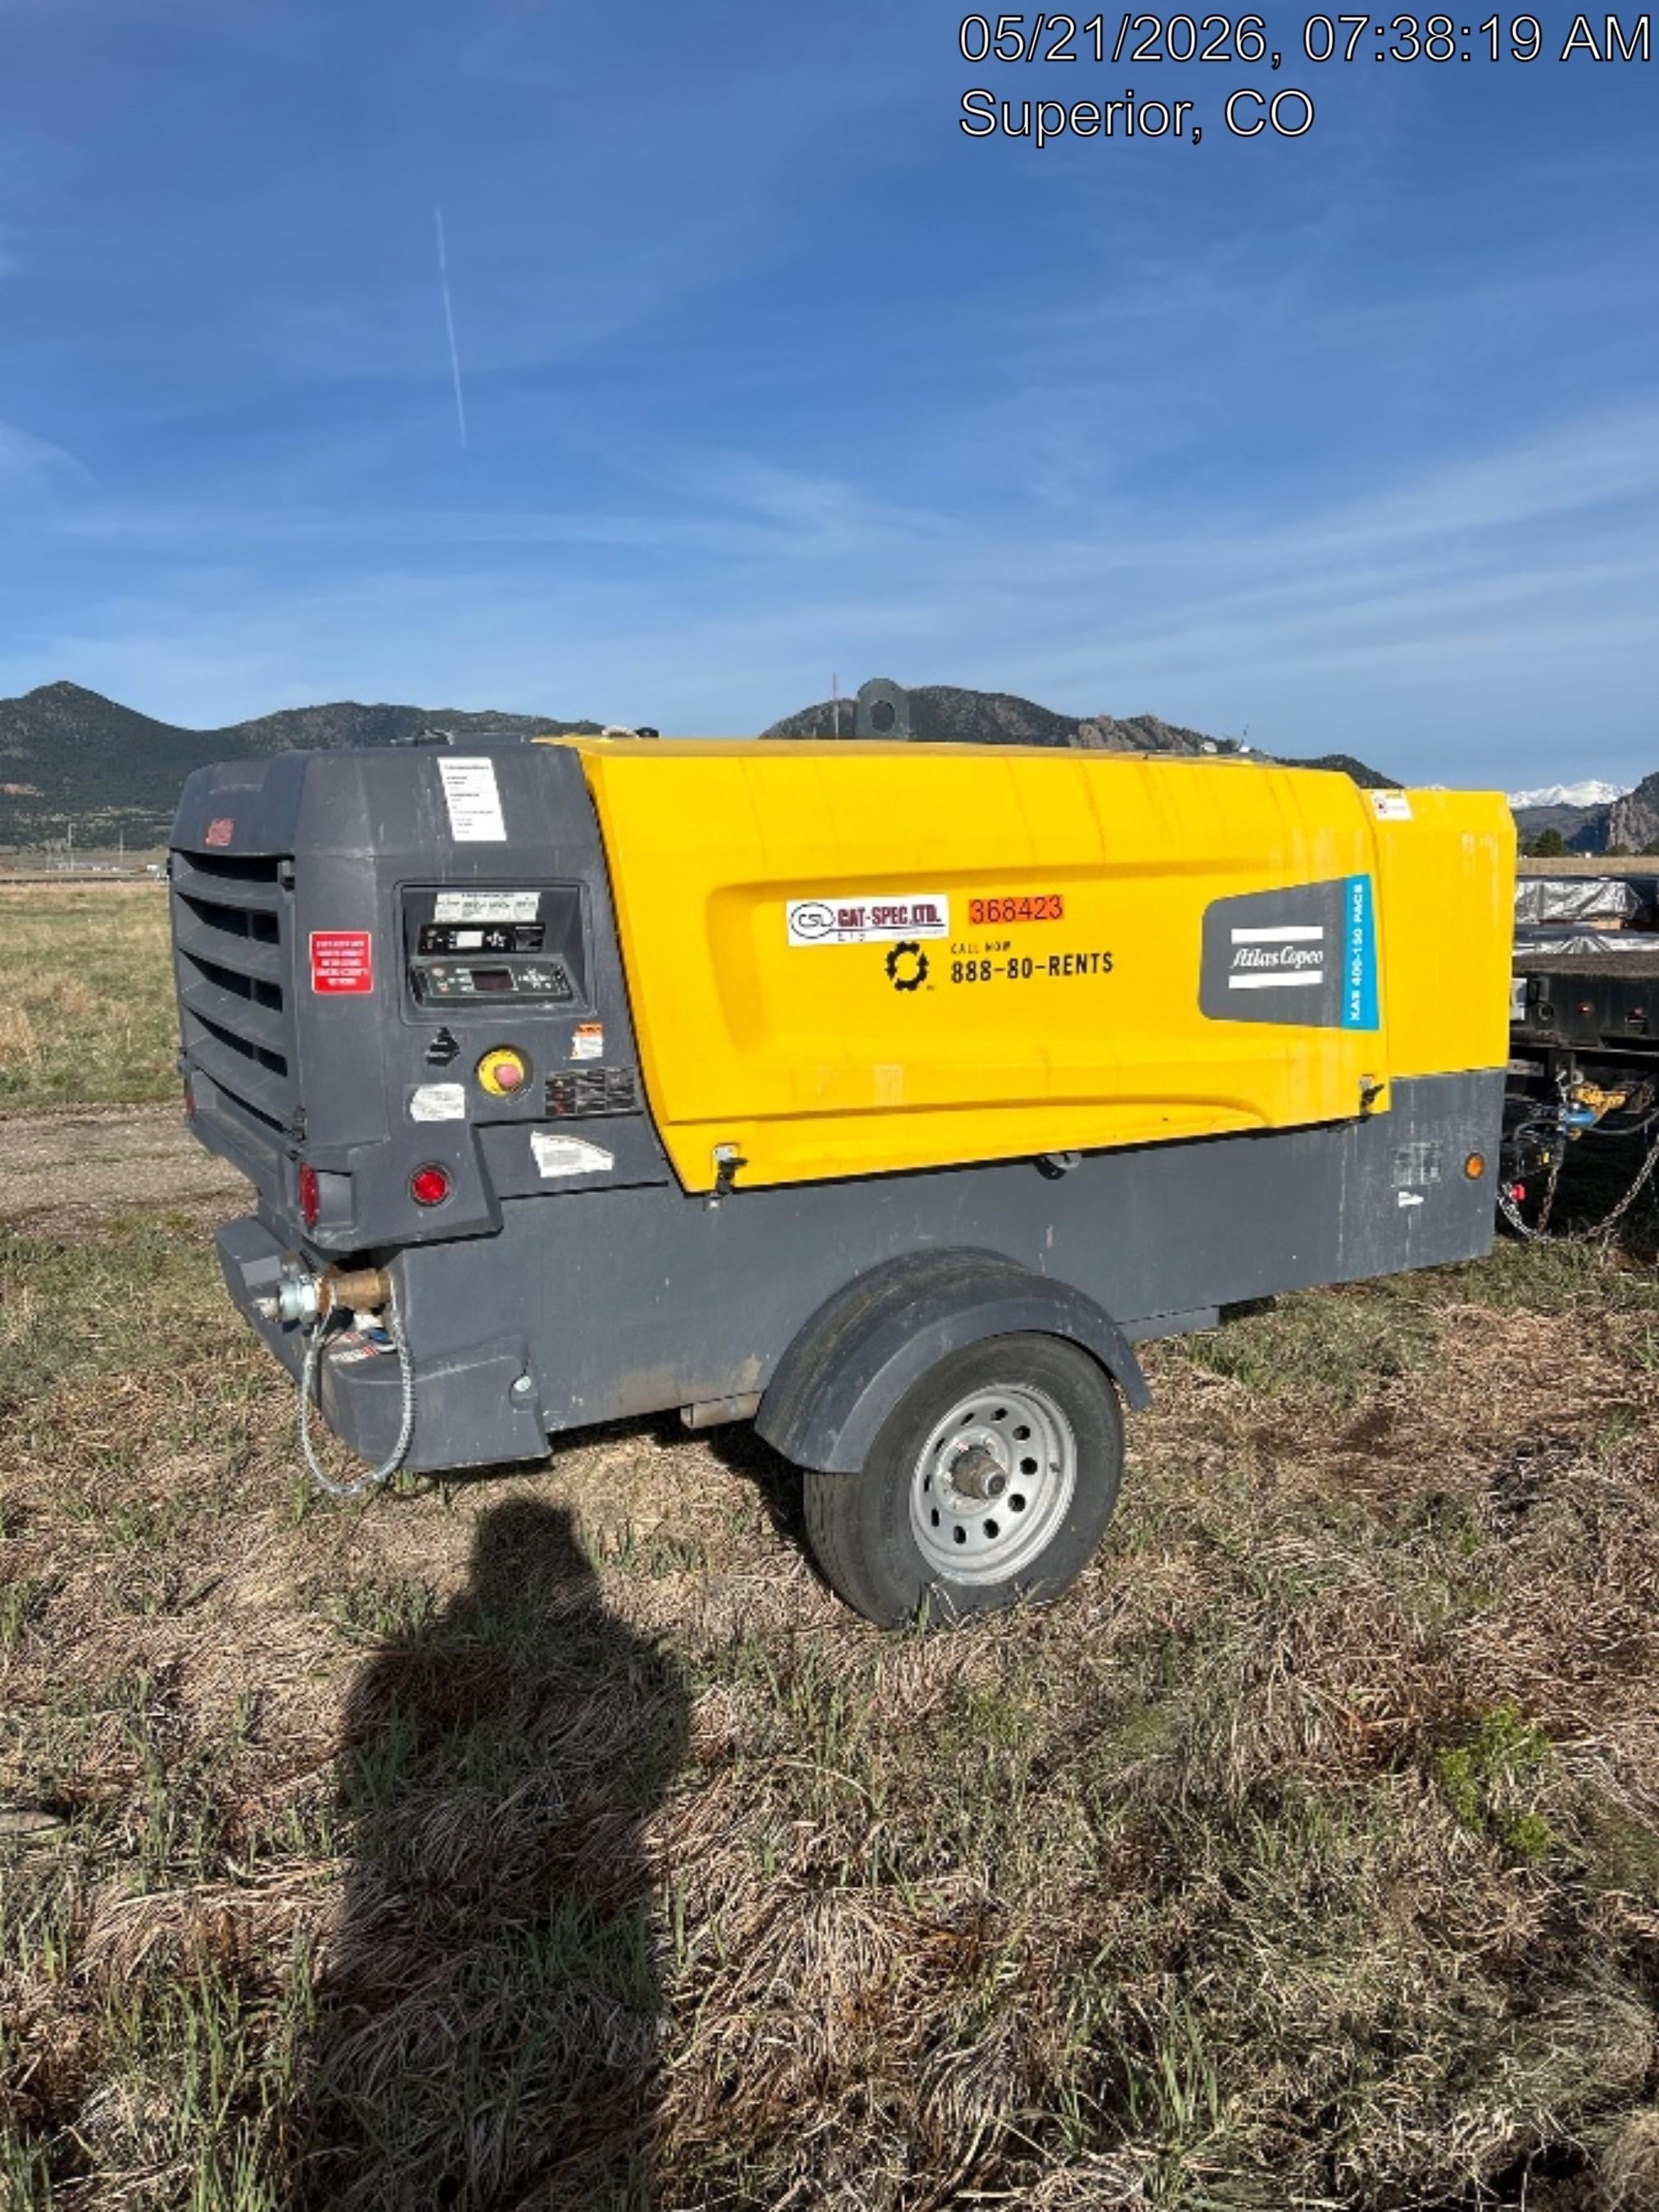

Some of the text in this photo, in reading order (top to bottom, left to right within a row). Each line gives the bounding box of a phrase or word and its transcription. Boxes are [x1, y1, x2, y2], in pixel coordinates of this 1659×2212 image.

[970, 895, 1063, 925] 368423
[950, 943, 980, 954] CALL
[1229, 945, 1324, 969] Atlas Copco
[950, 951, 1113, 983] 888-80-RENTS
